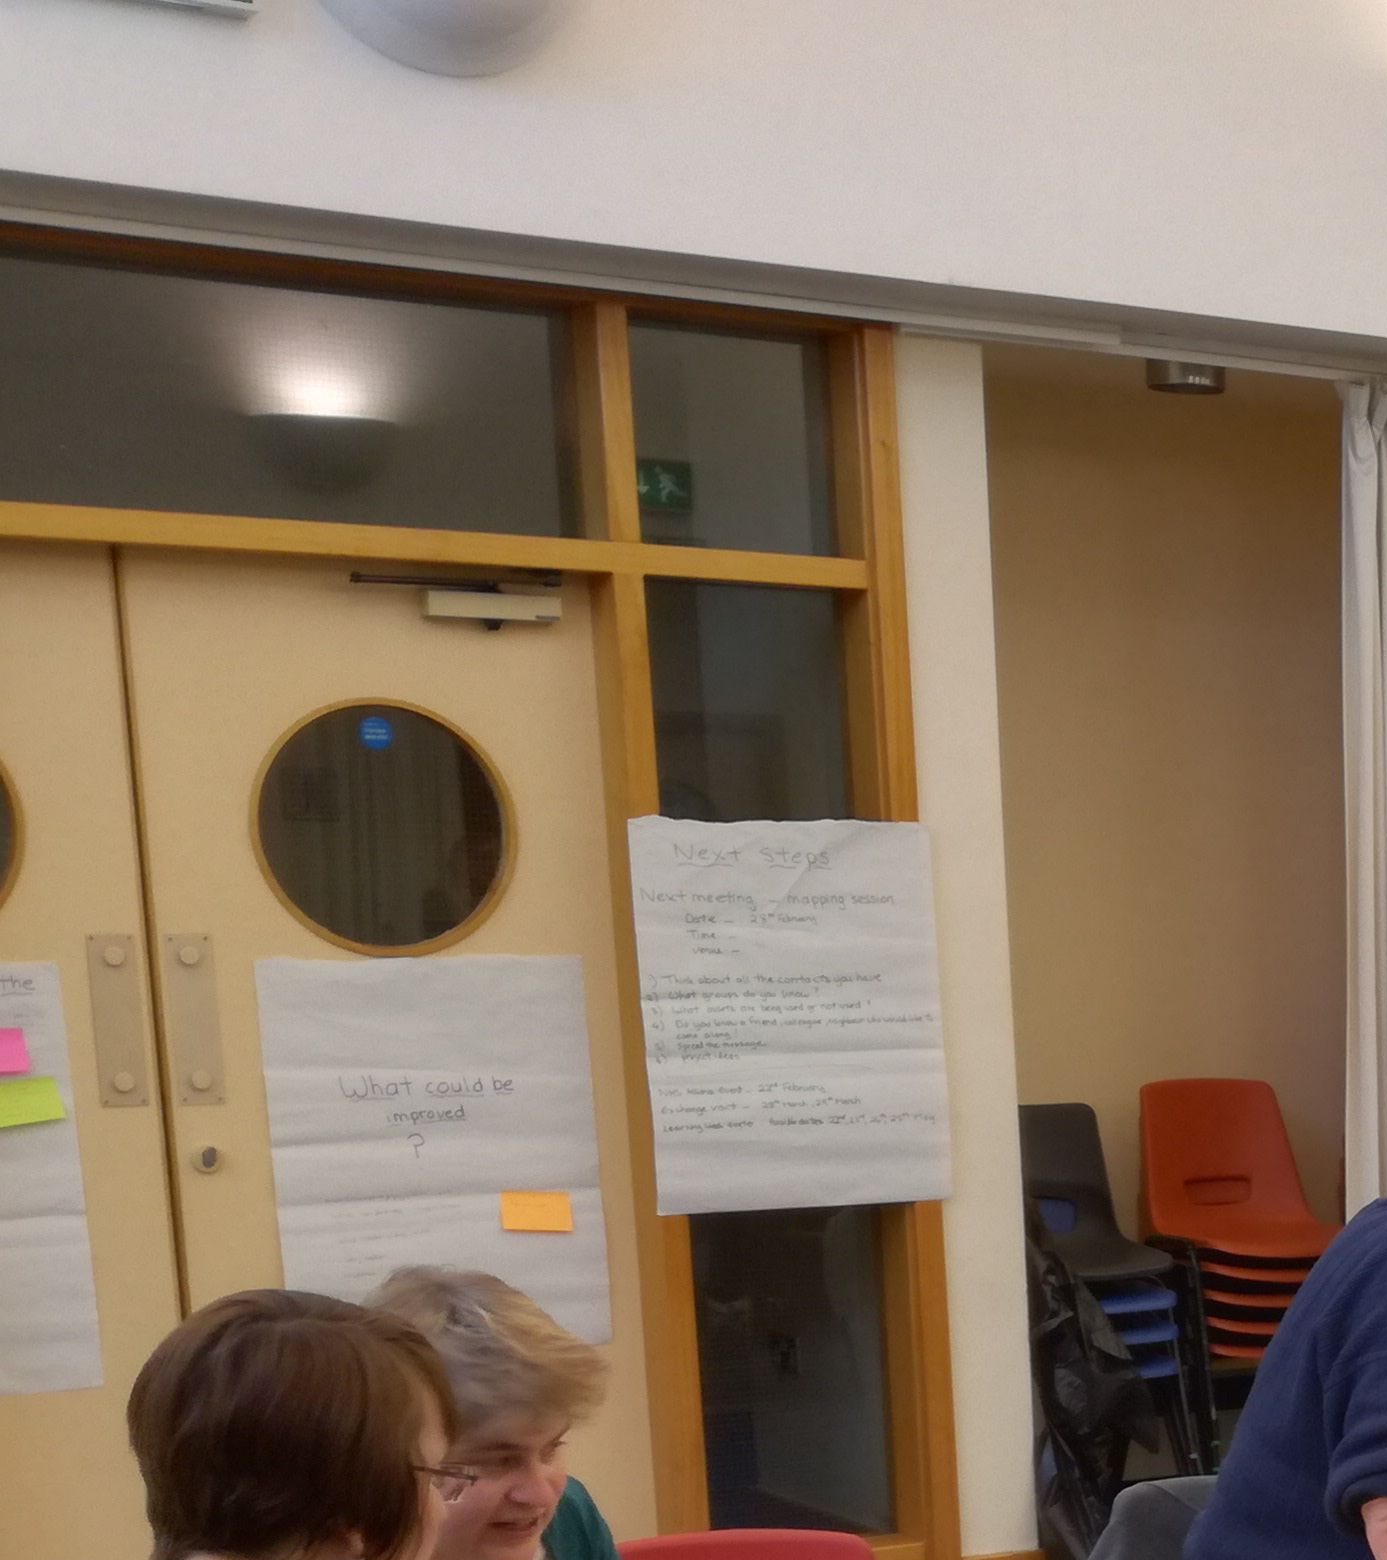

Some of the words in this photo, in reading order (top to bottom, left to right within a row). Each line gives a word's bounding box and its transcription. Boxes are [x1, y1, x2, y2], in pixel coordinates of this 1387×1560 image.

[673, 843, 741, 862] Next
[760, 847, 830, 872] Steps
[640, 888, 687, 903] Next
[692, 890, 757, 911] meeting
[787, 894, 847, 911] mapping
[851, 895, 896, 904] session
[339, 1073, 412, 1099] What
[425, 1076, 484, 1096] could
[492, 1075, 515, 1092] be
[387, 1104, 466, 1125] improved
[407, 1132, 426, 1159] ?
